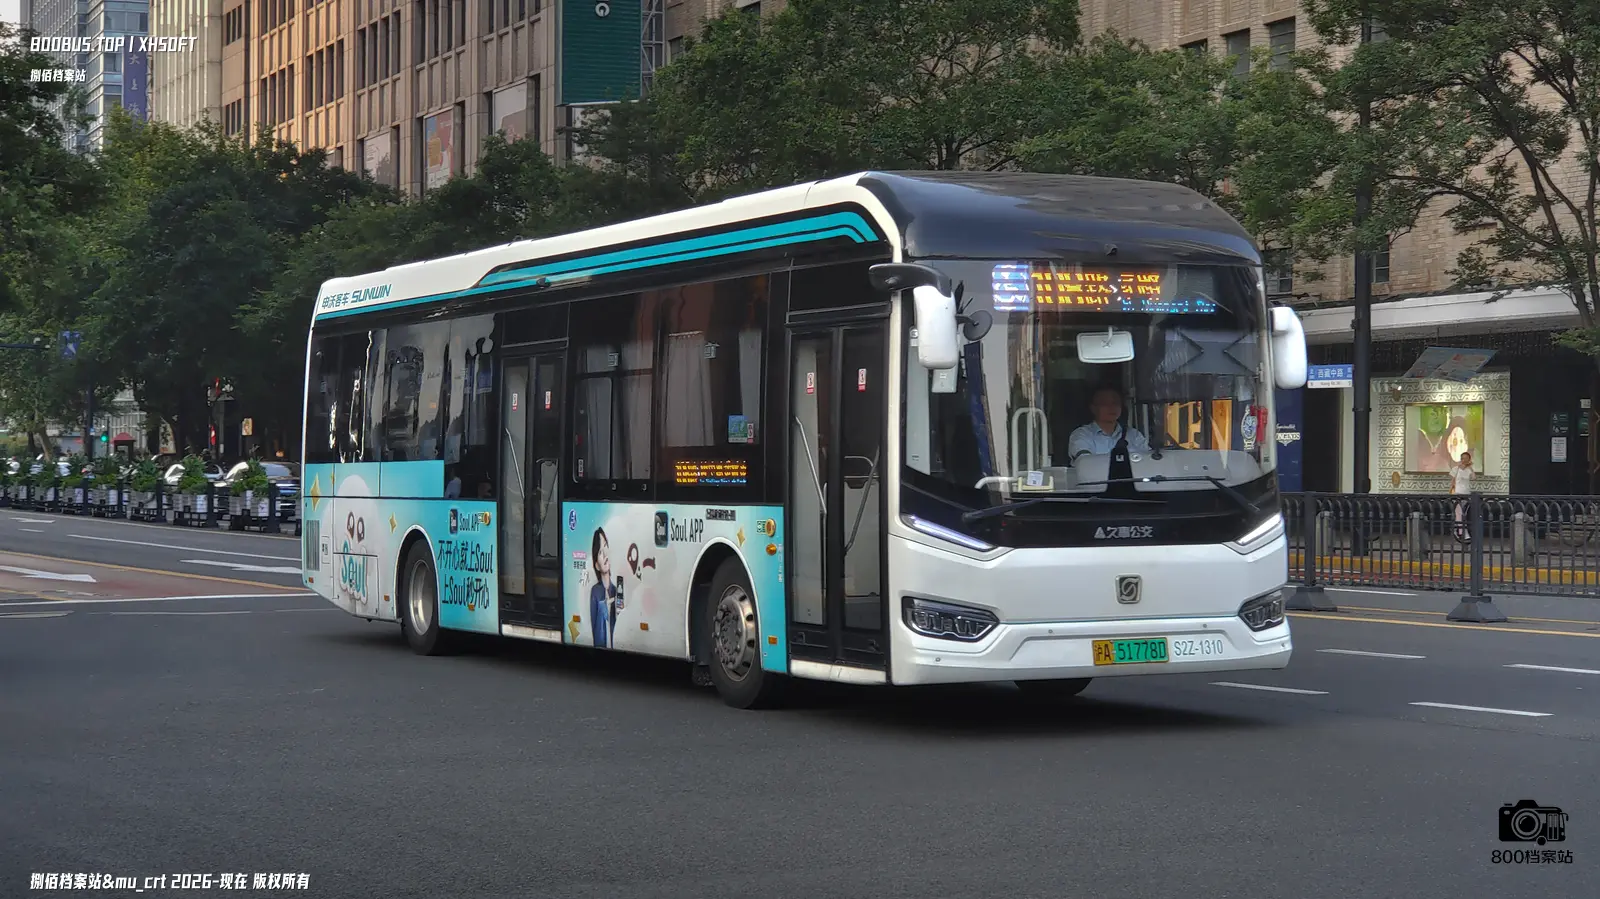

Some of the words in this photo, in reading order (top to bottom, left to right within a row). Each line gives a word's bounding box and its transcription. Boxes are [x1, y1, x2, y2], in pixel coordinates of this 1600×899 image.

[350, 284, 392, 303] SUNWIN
[459, 513, 470, 532] Soul
[670, 517, 688, 542] Soul
[689, 516, 704, 543] APP
[437, 540, 493, 573] 不开心就上Soul
[1117, 639, 1167, 661] 51778D
[1173, 639, 1224, 657] S2Z-1310
